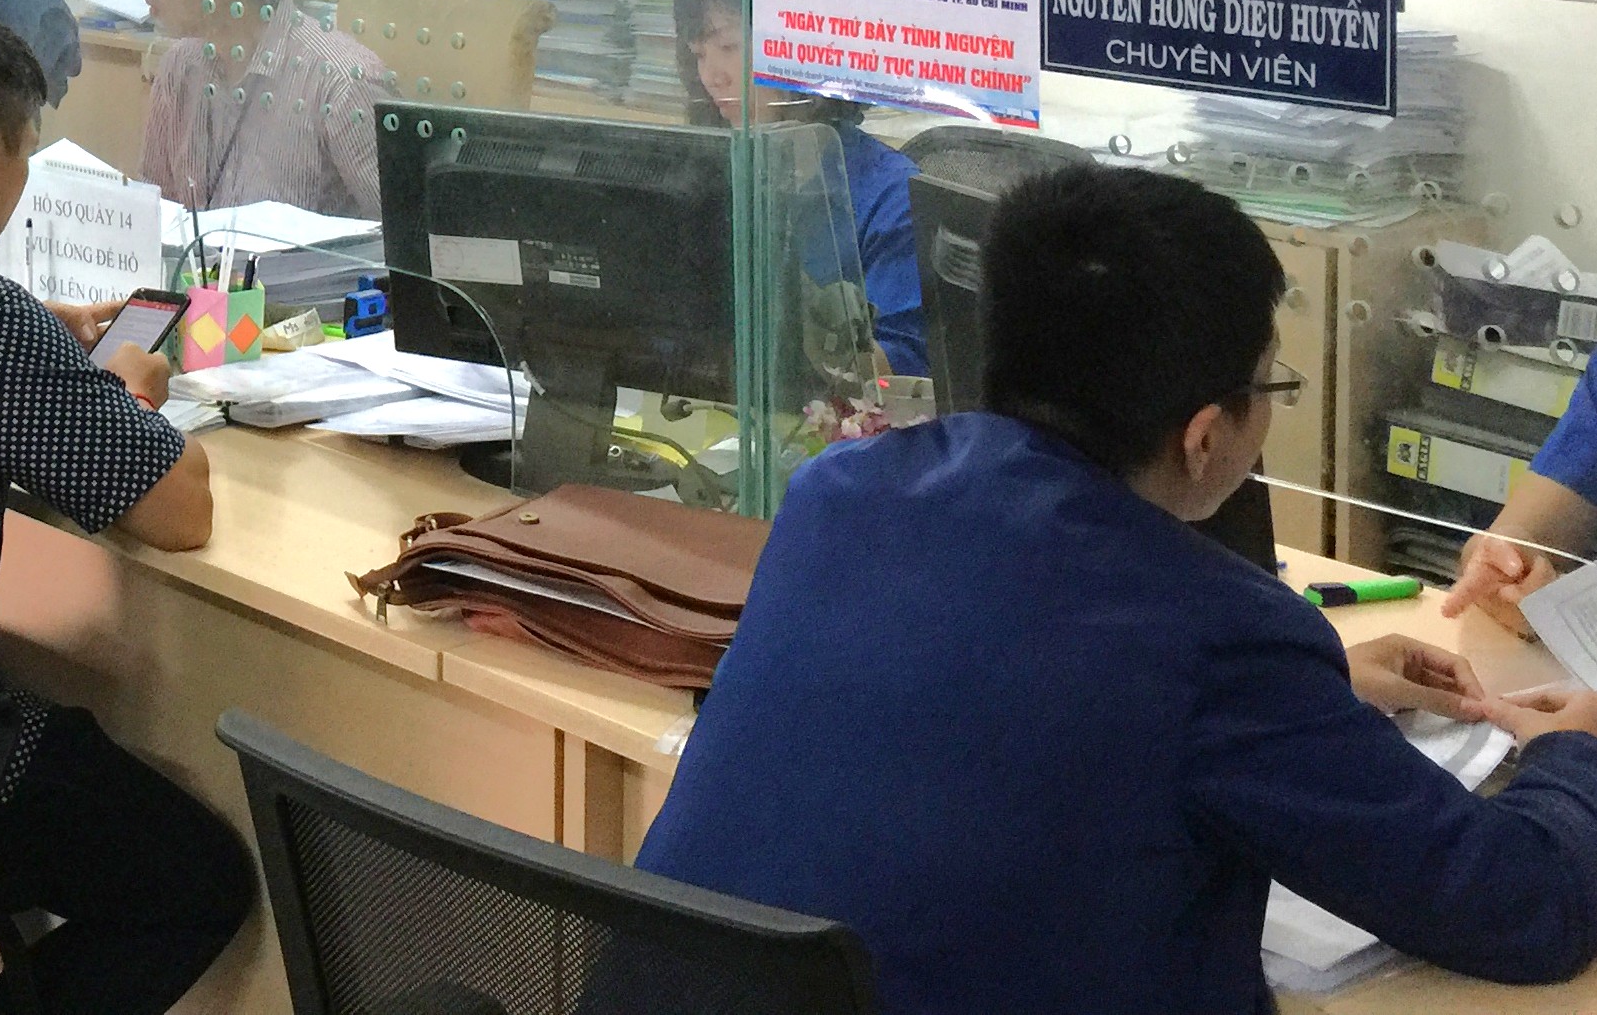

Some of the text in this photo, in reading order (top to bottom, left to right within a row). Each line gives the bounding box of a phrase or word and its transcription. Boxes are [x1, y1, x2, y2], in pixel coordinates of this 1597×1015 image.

[763, 35, 793, 60] GIẢI
[797, 40, 844, 67] QUYẾT
[847, 48, 880, 73] THỦ
[883, 54, 915, 79] TỤC
[918, 58, 966, 85] HÀNH
[829, 15, 862, 38] THỨ
[864, 17, 898, 43] BẢY
[901, 23, 941, 50] TÌNH
[945, 33, 1015, 62] NGUYỆN
[1105, 37, 1317, 89] CHUYÊN VIÊN
[55, 199, 72, 218] SƠ
[120, 211, 133, 230] 14
